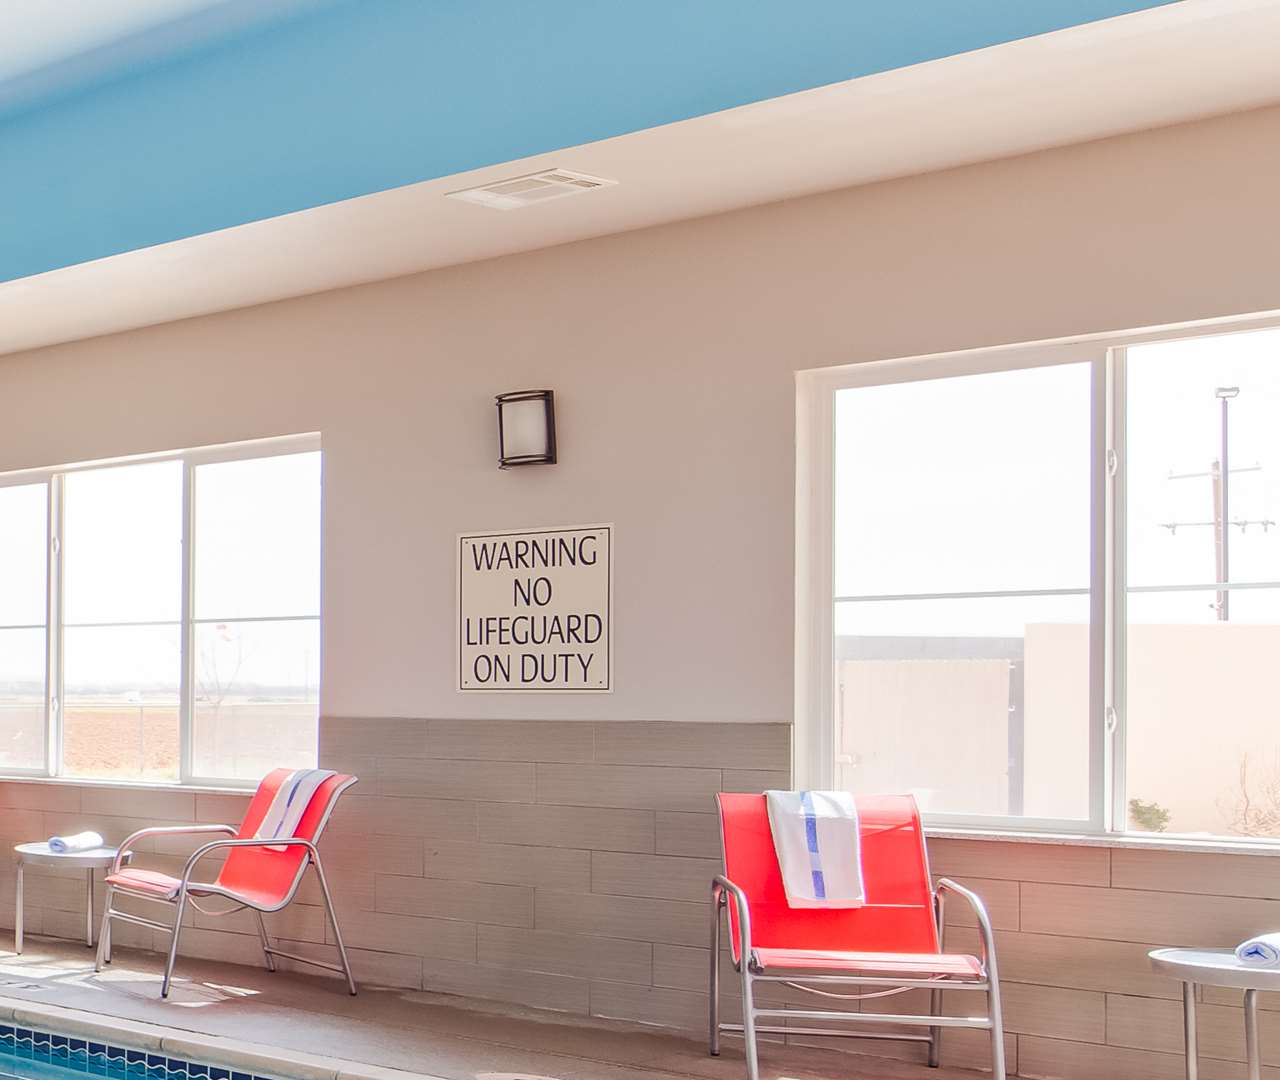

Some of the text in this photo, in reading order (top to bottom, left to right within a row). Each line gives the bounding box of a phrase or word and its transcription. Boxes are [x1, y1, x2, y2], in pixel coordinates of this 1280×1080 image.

[472, 535, 597, 571] WARNING
[513, 576, 553, 607] NO
[466, 613, 603, 646] LIFEGUARD
[473, 652, 594, 684] ON DUTY
